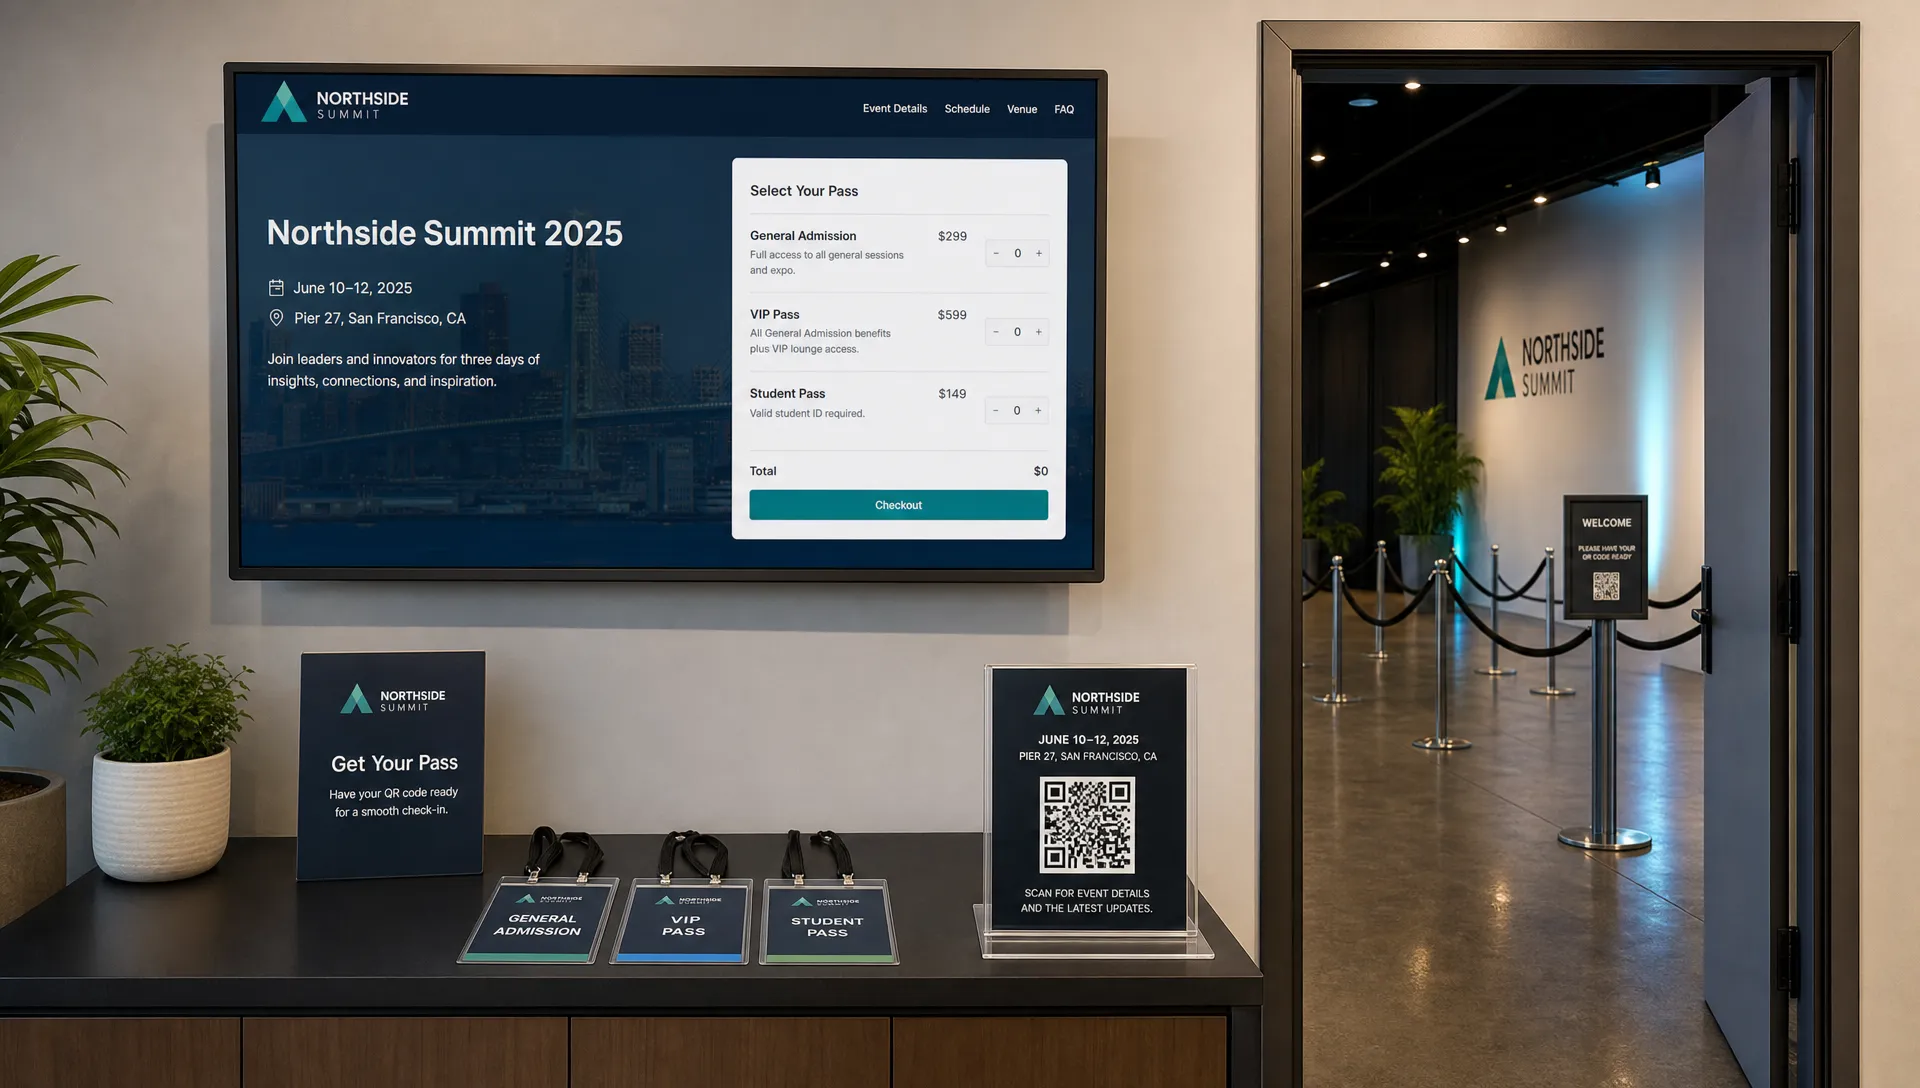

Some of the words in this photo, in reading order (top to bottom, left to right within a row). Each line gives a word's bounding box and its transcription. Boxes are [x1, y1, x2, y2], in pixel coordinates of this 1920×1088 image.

[317, 91, 409, 106] NORTHSIDE
[317, 108, 380, 120] SUMMIT
[863, 103, 892, 113] Event
[893, 103, 928, 114] Details
[944, 103, 991, 114] Schedule
[1006, 104, 1038, 114] Venue
[1054, 104, 1075, 115] FAQ
[750, 184, 793, 197] Select
[795, 184, 826, 197] Your
[828, 185, 859, 197] Pass
[267, 218, 417, 246] Northside
[423, 219, 536, 247] Summit
[544, 219, 623, 247] 2025
[750, 230, 795, 241] General
[797, 230, 857, 241] Admission
[938, 230, 968, 242] $299
[750, 249, 767, 260] Full
[768, 251, 802, 260] access
[803, 250, 814, 260] to
[815, 250, 826, 260] all
[827, 250, 863, 262] general
[864, 250, 905, 260] sessions
[1014, 248, 1022, 258] 0
[749, 265, 768, 275] and
[770, 267, 796, 277] expo.
[293, 281, 326, 294] June
[329, 281, 373, 296] 10–12,
[377, 281, 413, 295] 2025
[294, 311, 321, 325] Pier
[324, 311, 344, 327] 27,
[348, 311, 373, 325] San
[377, 311, 443, 327] Francisco,
[446, 311, 467, 325] CA
[750, 308, 771, 320] VIP
[773, 309, 800, 320] Pass
[937, 309, 967, 321] $599
[749, 328, 763, 338] All
[764, 328, 802, 338] General
[803, 328, 853, 338] Admission
[854, 328, 892, 338] benefits
[1013, 326, 1022, 337] 0
[749, 344, 770, 355] plus
[771, 343, 789, 354] VIP
[790, 344, 823, 356] lounge
[824, 346, 860, 354] access.
[1522, 326, 1605, 367] NORTHSIDE
[267, 352, 294, 365] Join
[297, 353, 343, 365] leaders
[346, 353, 370, 365] and
[373, 353, 437, 366] innovators
[439, 353, 458, 365] for
[460, 353, 493, 366] three
[495, 353, 525, 368] days
[527, 353, 541, 366] of
[267, 374, 319, 390] insights,
[322, 374, 400, 389] connections,
[403, 374, 427, 387] and
[430, 374, 497, 390] inspiration.
[1522, 369, 1575, 397] SUMMIT
[749, 387, 796, 399] Student
[799, 388, 826, 399] Pass
[938, 387, 967, 400] $149
[749, 408, 773, 418] Valid
[775, 408, 811, 418] student
[812, 408, 823, 418] ID
[824, 408, 866, 420] required.
[1013, 405, 1021, 416] 0
[749, 465, 777, 476] Total
[1033, 465, 1049, 477] $0
[875, 500, 923, 510] Checkout
[1581, 517, 1632, 528] WELCOME
[1618, 544, 1636, 552] YOUR
[1592, 553, 1610, 561] CODE
[380, 690, 446, 701] NORTHSIDE
[1072, 691, 1140, 703] NORTHSIDE
[380, 702, 429, 712] SUMMIT
[1072, 705, 1123, 715] SUMMIT
[1038, 734, 1070, 745] JUNE
[1072, 734, 1110, 747] 10–12,
[1112, 734, 1140, 745] 2025
[1019, 751, 1041, 761] PIER
[1043, 751, 1058, 763] 27,
[1060, 751, 1081, 761] SAN
[1083, 751, 1141, 762] FRANCISCO,
[1143, 751, 1158, 761] CA
[331, 755, 366, 773] Get
[371, 754, 414, 772] Your
[419, 754, 459, 771] Pass
[329, 789, 357, 800] Have
[358, 790, 382, 801] your
[384, 787, 400, 799] QR
[402, 787, 428, 798] code
[430, 786, 459, 799] ready
[334, 806, 350, 818] for
[351, 808, 359, 817] a
[361, 805, 400, 817] smooth
[401, 804, 449, 816] check-in.
[1024, 888, 1053, 898] SCAN
[1055, 888, 1075, 898] FOR
[1077, 888, 1109, 898] EVENT
[1111, 888, 1150, 899] DETAILS
[1020, 903, 1043, 913] AND
[1044, 903, 1065, 913] THE
[1067, 903, 1104, 913] LATEST
[1106, 903, 1153, 914] UPDATES.
[508, 914, 577, 923] GENERAL
[671, 915, 701, 924] VIP
[791, 917, 864, 926] STUDENT
[493, 926, 581, 936] ADMISSION
[662, 927, 706, 936] PASS
[807, 929, 848, 937] PASS
